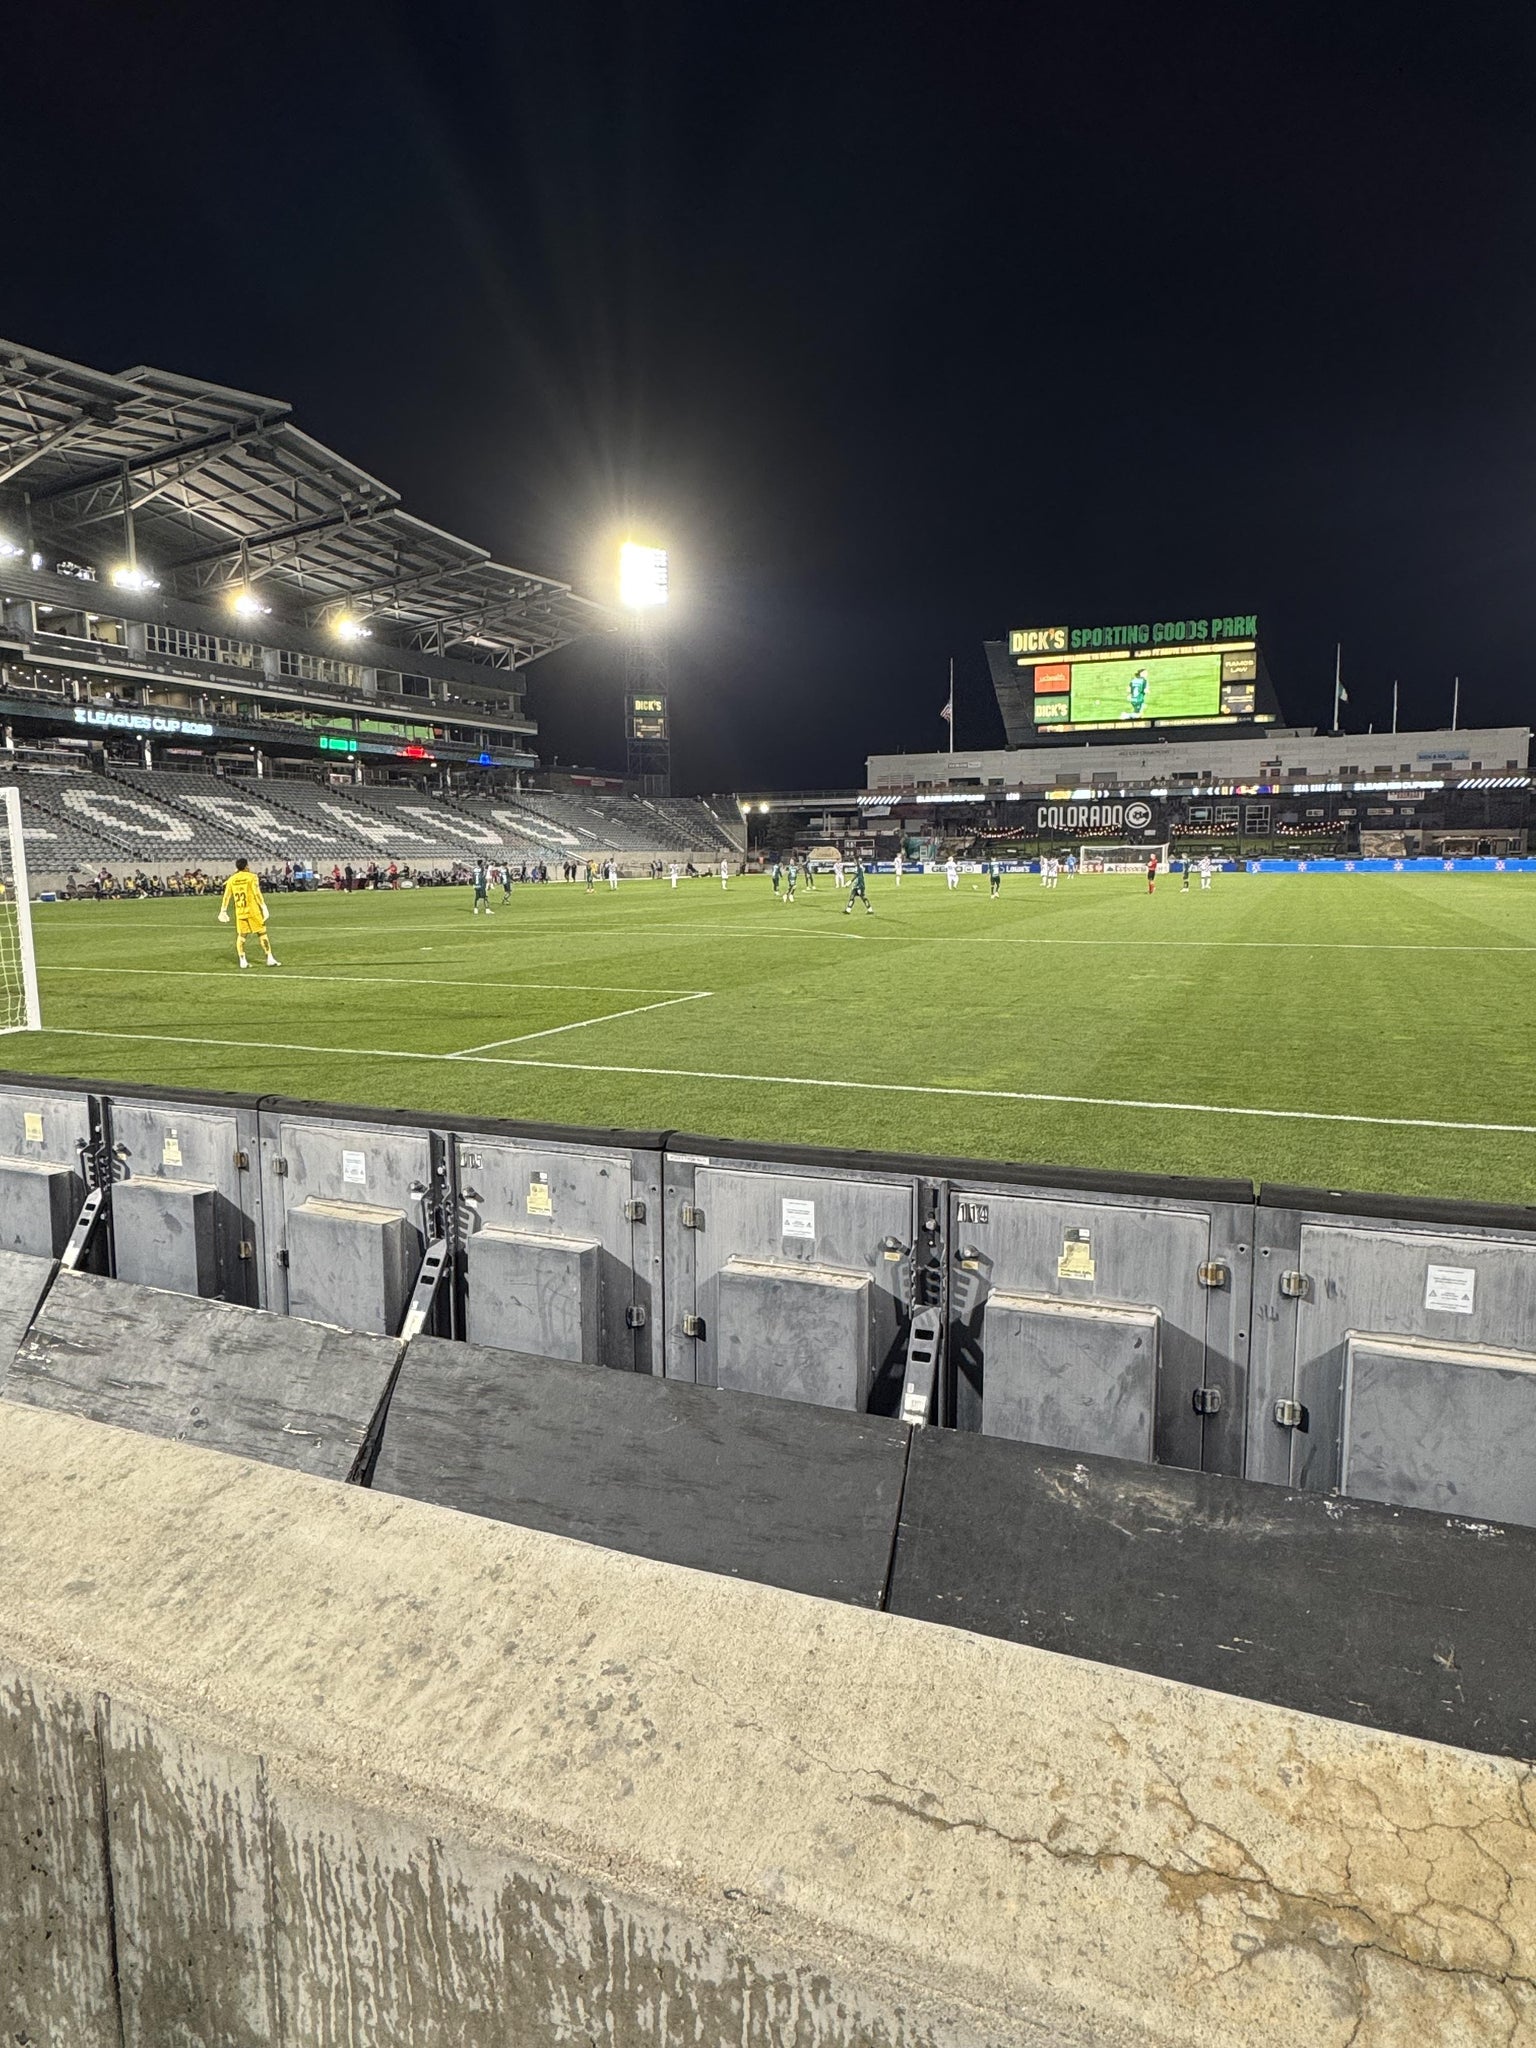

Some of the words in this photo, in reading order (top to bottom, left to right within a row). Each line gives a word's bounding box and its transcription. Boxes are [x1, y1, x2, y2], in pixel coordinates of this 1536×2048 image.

[1013, 630, 1065, 652] DICK'S
[1071, 623, 1149, 649] SPORTING
[1152, 619, 1208, 643] GOODS
[1211, 614, 1257, 638] PARK
[635, 700, 662, 711] DICK'S
[1036, 703, 1068, 717] DICK'S
[88, 710, 151, 729] LEAGUES
[153, 717, 180, 732] CUP
[1037, 804, 1124, 829] COLORADO
[957, 1202, 989, 1224] 114
